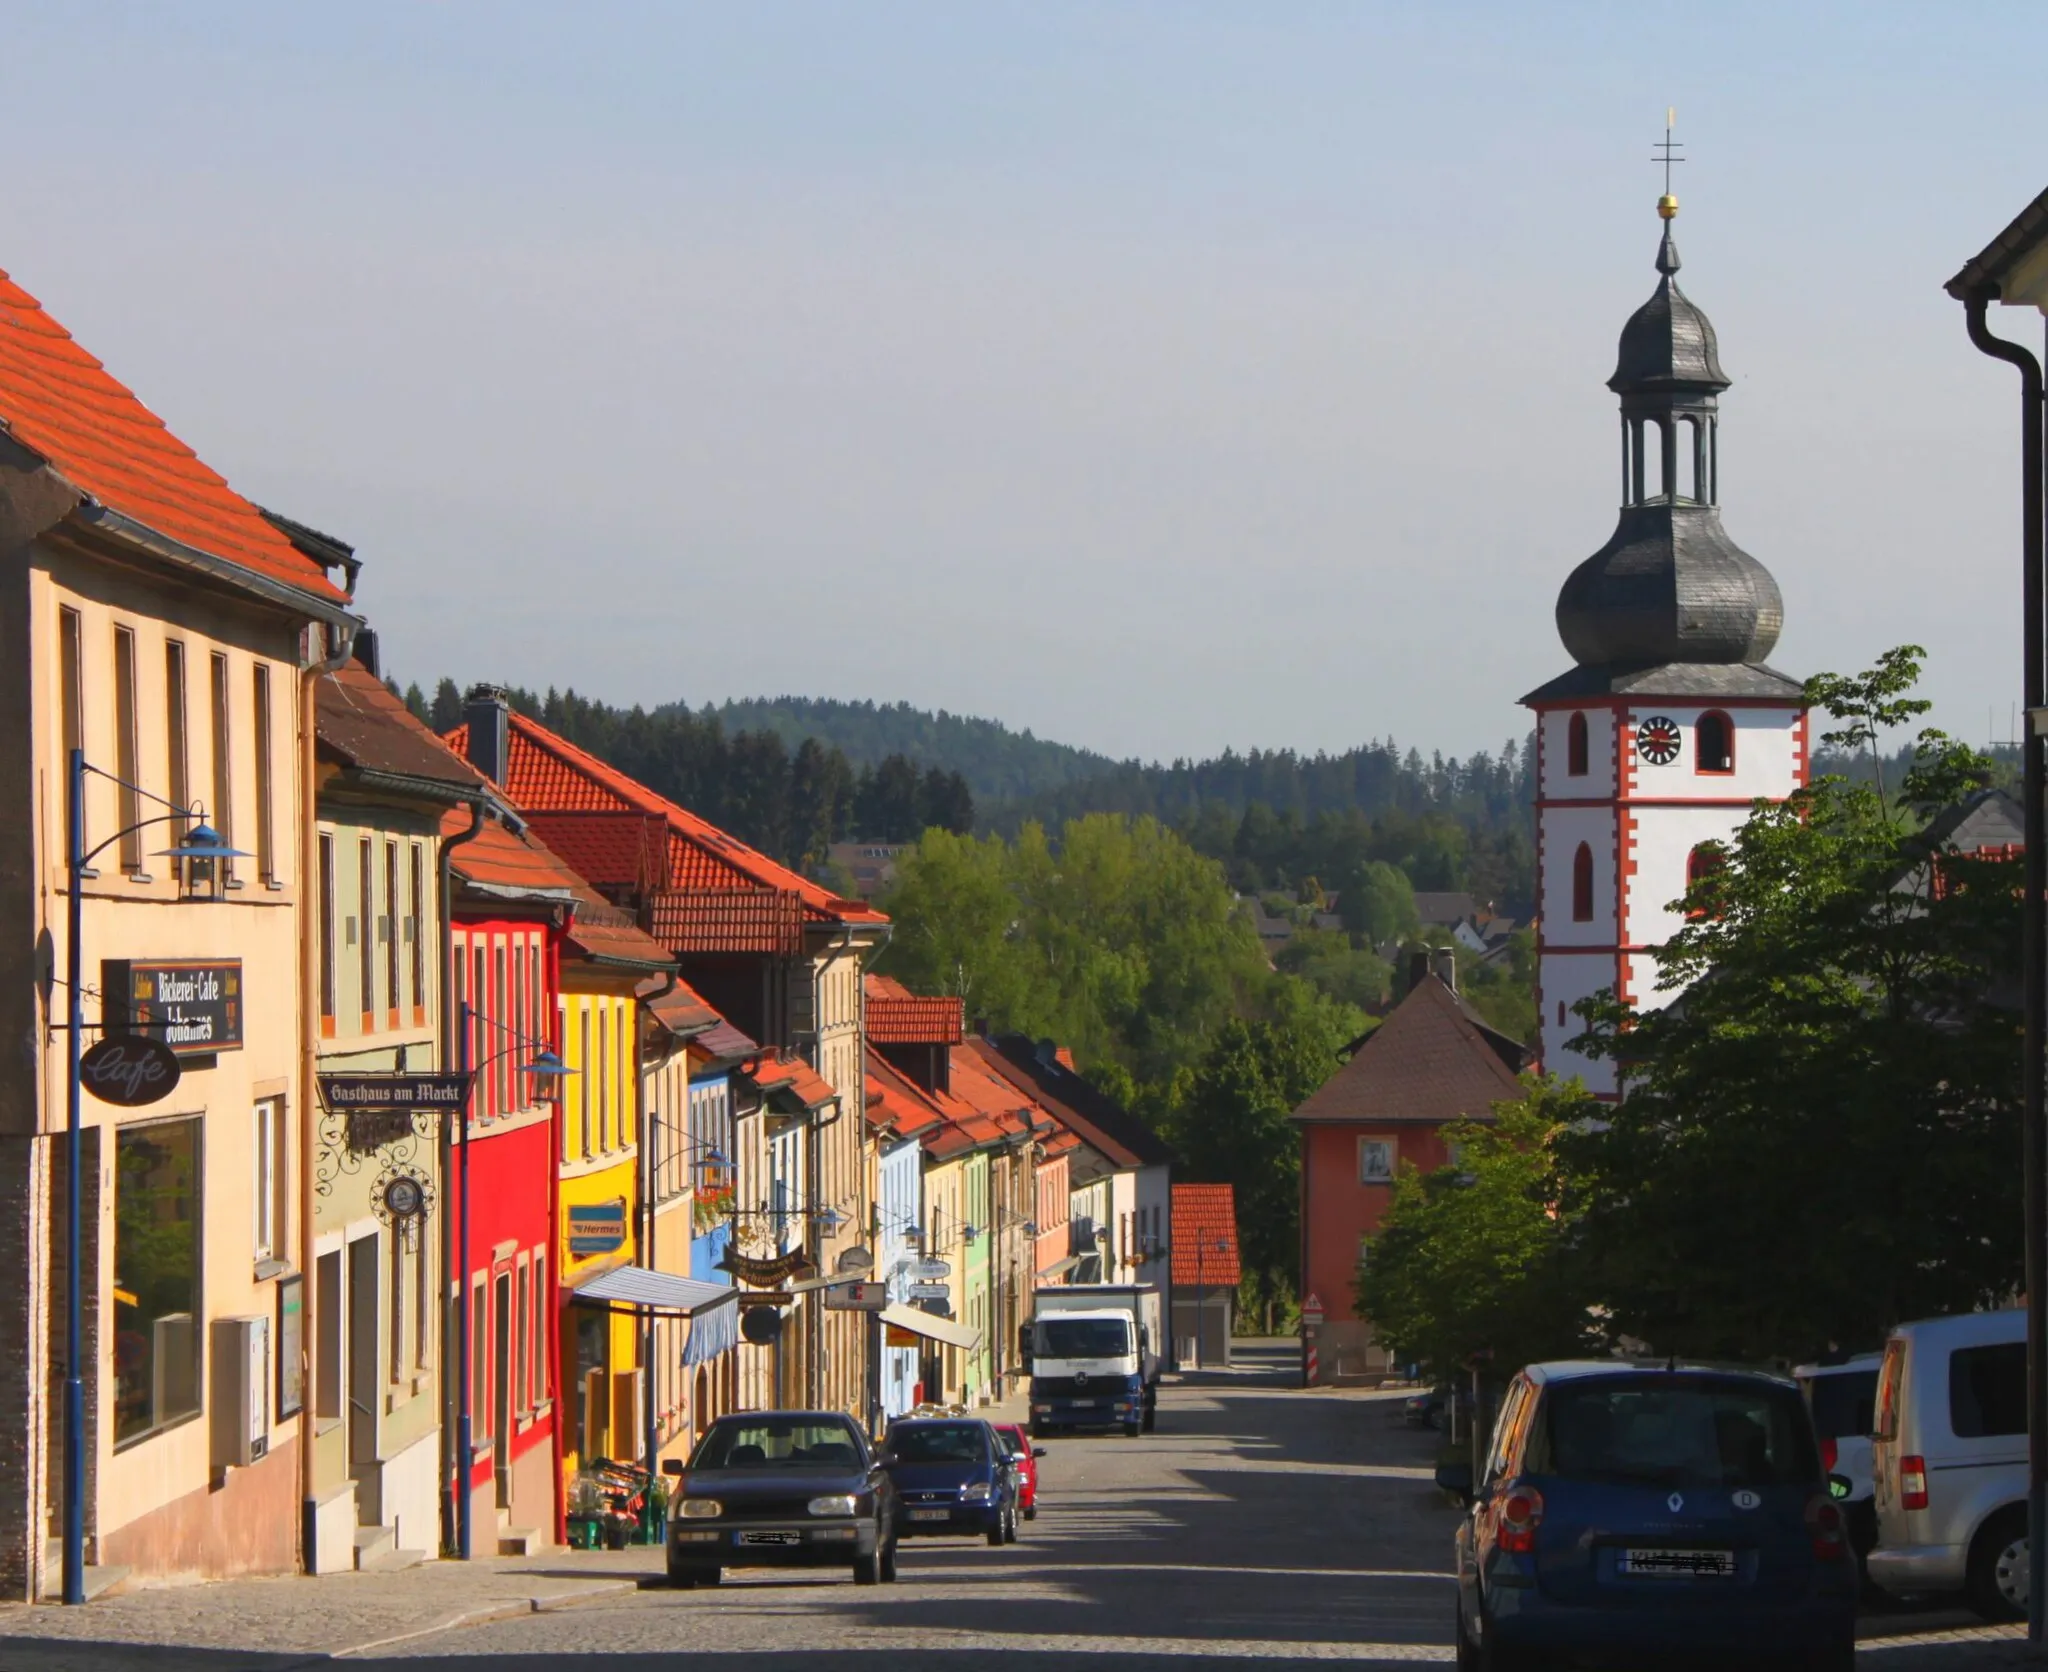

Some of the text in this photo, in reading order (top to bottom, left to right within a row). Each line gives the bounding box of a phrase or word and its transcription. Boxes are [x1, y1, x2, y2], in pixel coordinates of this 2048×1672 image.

[331, 1083, 459, 1103] Gasthaus am Markt
[583, 1224, 621, 1234] Hermes
[1742, 1494, 1753, 1506] D
